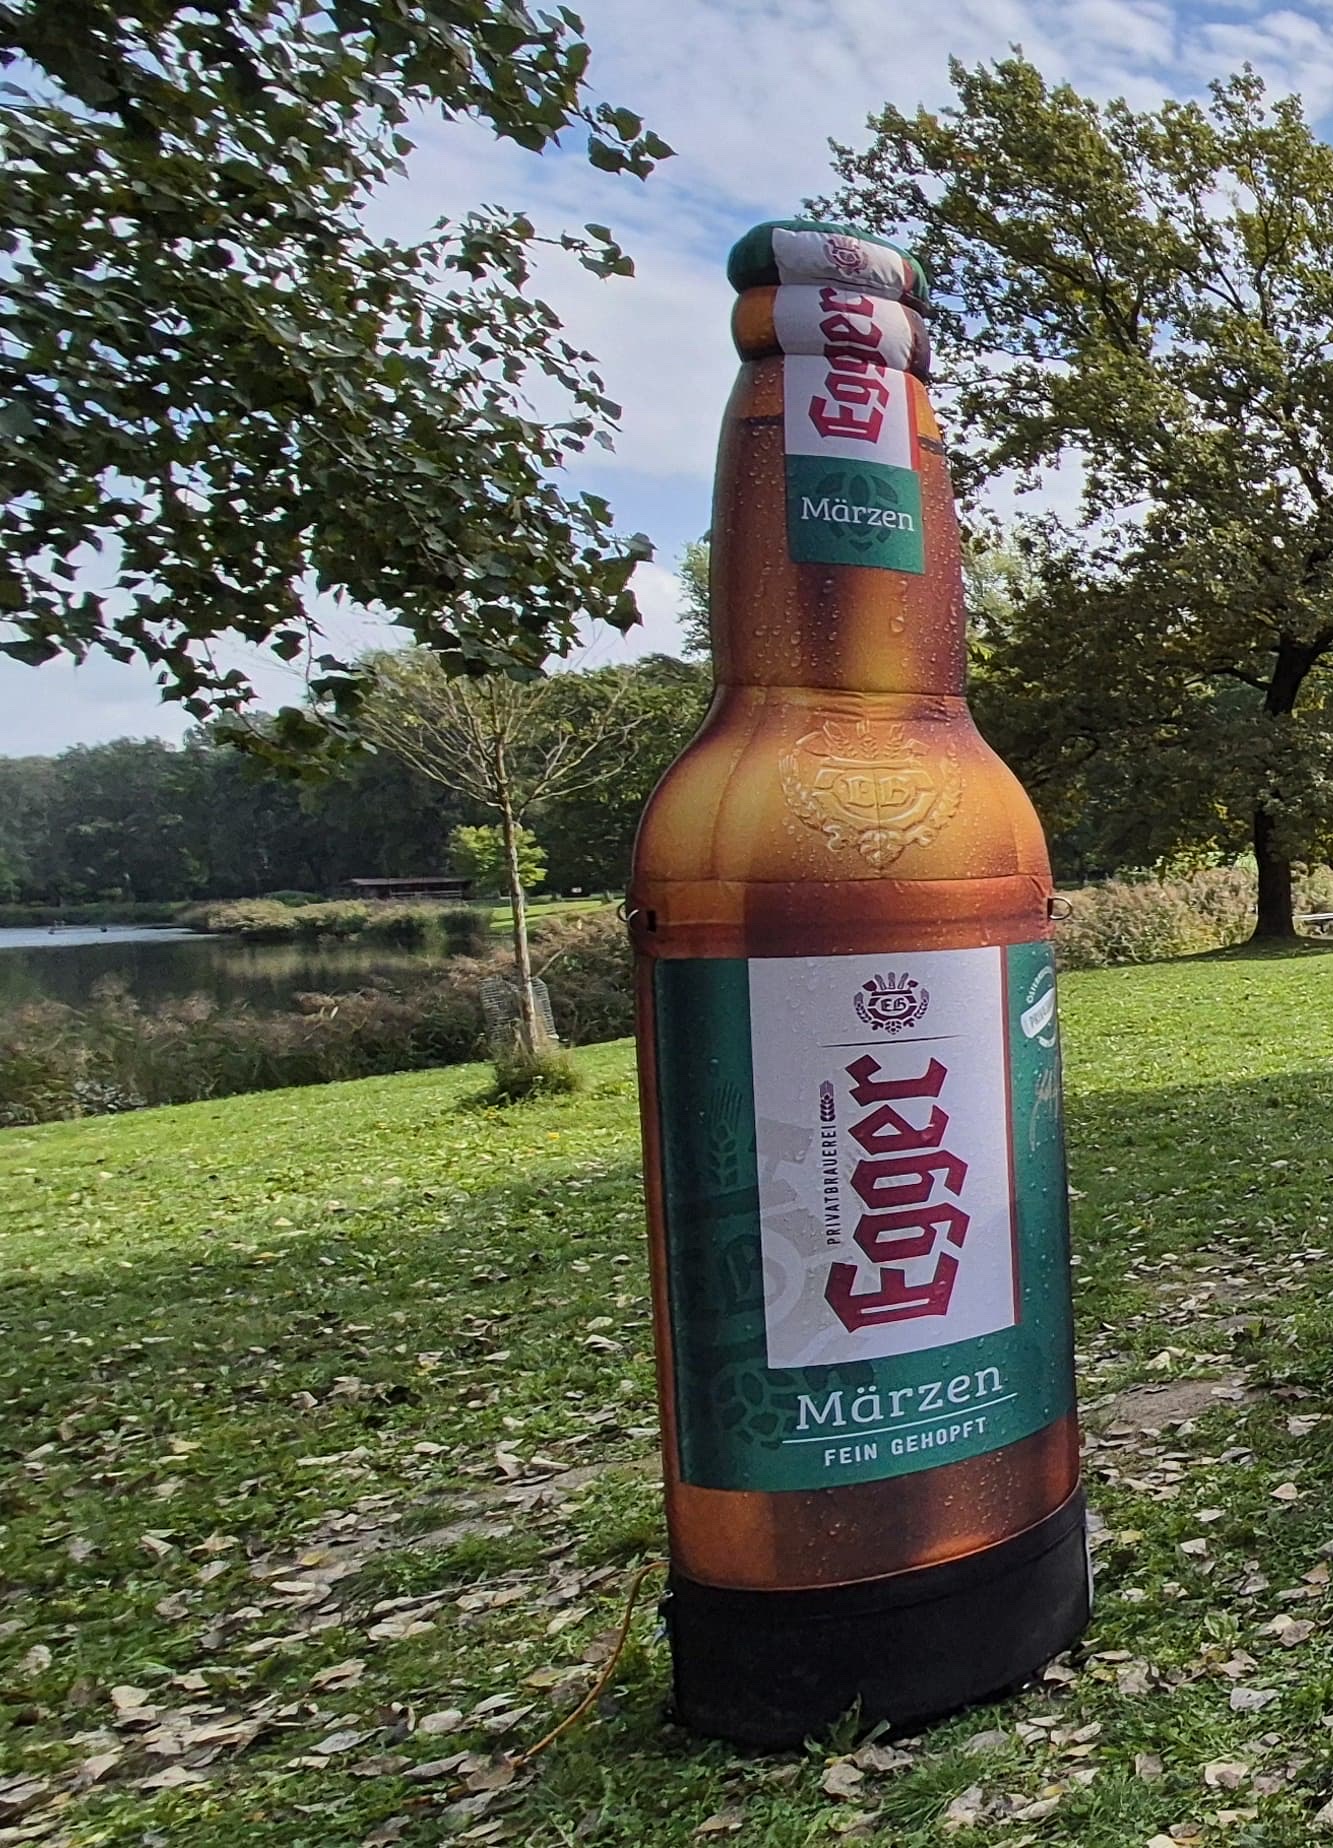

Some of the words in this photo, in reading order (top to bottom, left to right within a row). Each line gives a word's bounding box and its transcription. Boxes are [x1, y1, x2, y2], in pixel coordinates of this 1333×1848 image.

[808, 287, 888, 444] Egger
[800, 496, 914, 532] Märzen
[821, 1124, 842, 1246] PRIVATBRAUEREI
[823, 1054, 970, 1334] Egger
[796, 1364, 1004, 1431] Märzen
[824, 1442, 878, 1467] FEIN
[891, 1416, 987, 1455] GEHOPFT
